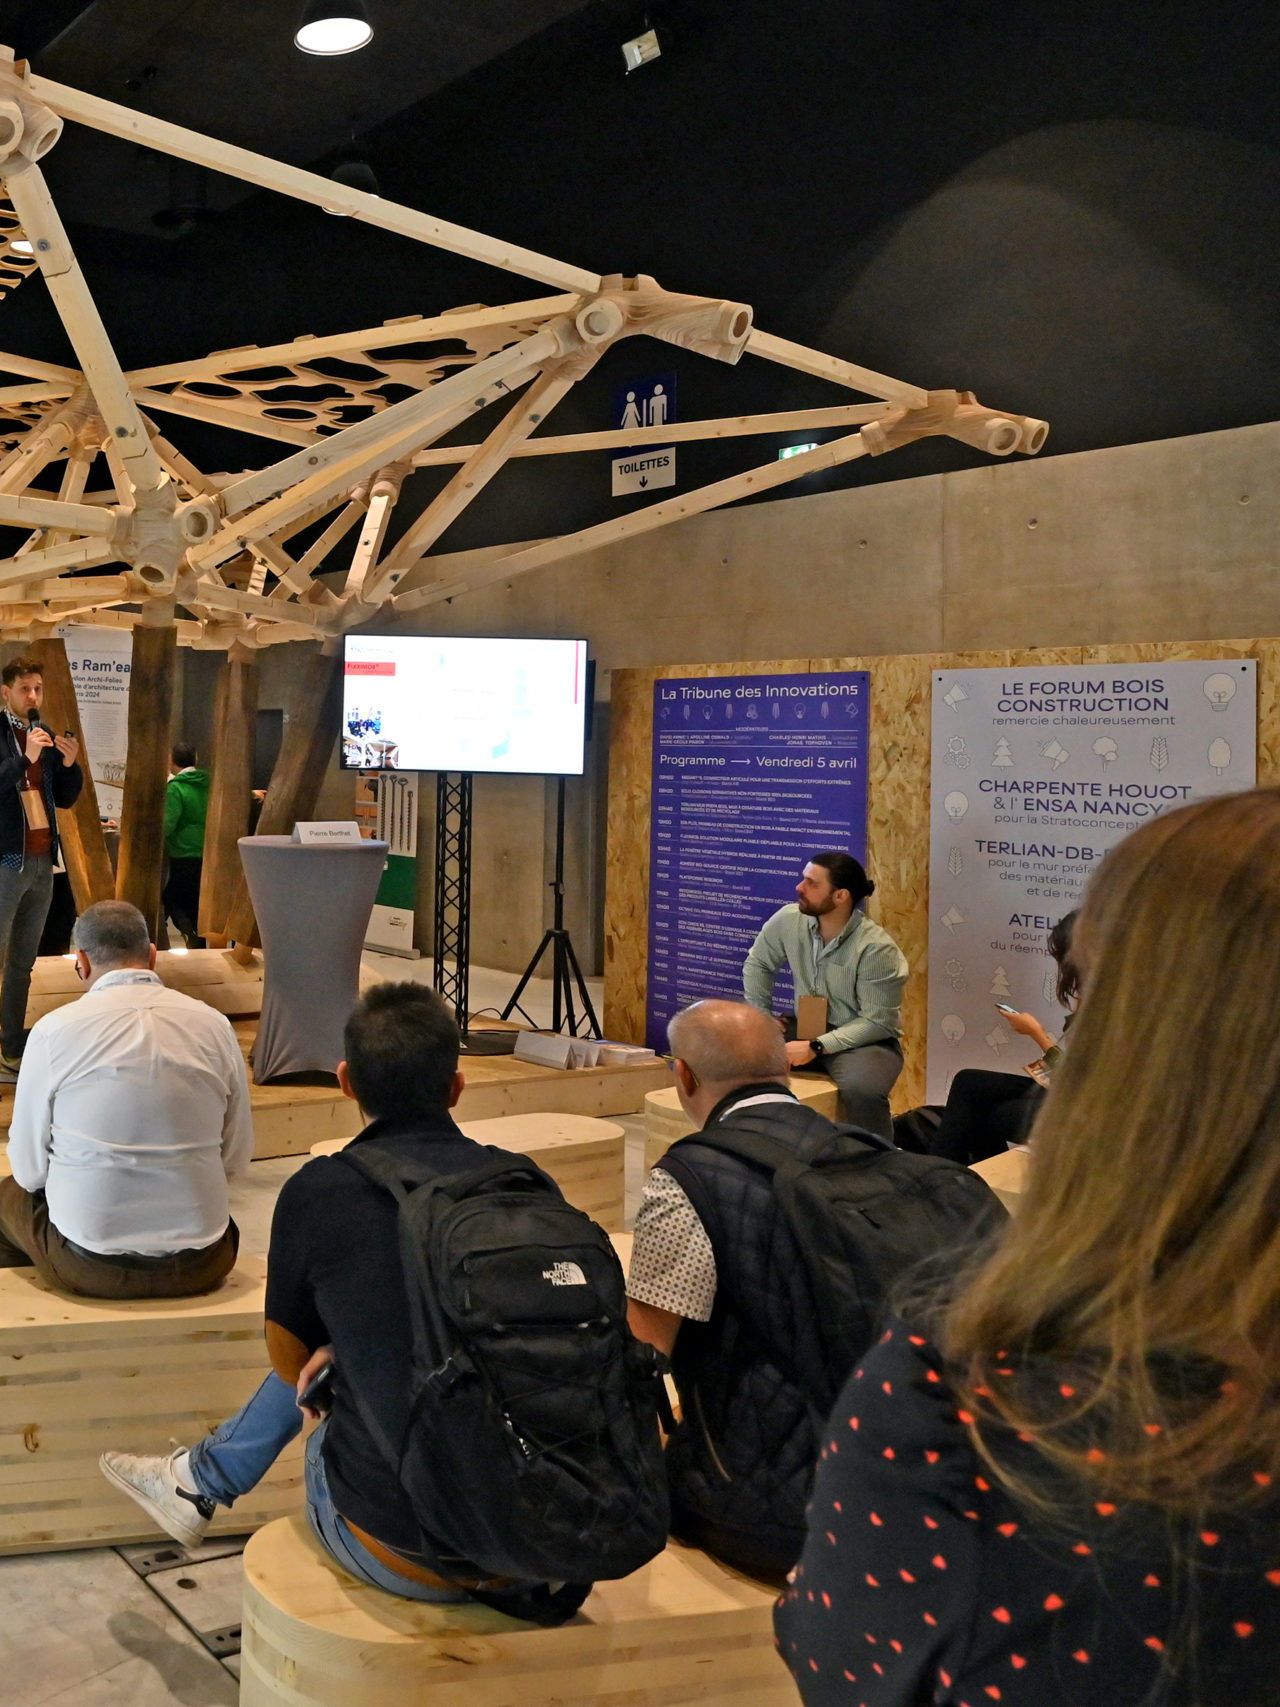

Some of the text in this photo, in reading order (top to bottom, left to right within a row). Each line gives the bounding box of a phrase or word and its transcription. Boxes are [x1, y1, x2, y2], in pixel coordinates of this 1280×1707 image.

[618, 456, 670, 475] TOILETTES
[662, 682, 858, 700] La Tribune des Innovations
[1002, 679, 1164, 696] LE FORUM BOIS
[997, 697, 1169, 713] CONSTRUCTION
[993, 716, 1176, 726] remercie chaleureusement
[660, 755, 726, 767] Programme
[756, 756, 857, 769] Vendredi 5 avril
[978, 779, 1192, 800] CHARPENTE HOUOT
[993, 797, 1005, 810] &
[1024, 798, 1078, 814] ENSA
[994, 815, 1023, 825] pour
[1027, 815, 1037, 825] la
[989, 858, 1016, 869] pour
[1020, 860, 1030, 870] le
[1033, 862, 1059, 872] mur
[1000, 872, 1086, 887] des matériau
[1027, 887, 1039, 896] et
[1043, 887, 1060, 898] de
[1009, 914, 1059, 930] ATEL
[1013, 931, 1043, 942] pour
[990, 940, 1006, 951] du
[553, 1262, 569, 1271] THE
[542, 1270, 569, 1280] NORTH
[552, 1279, 572, 1287] FACE
